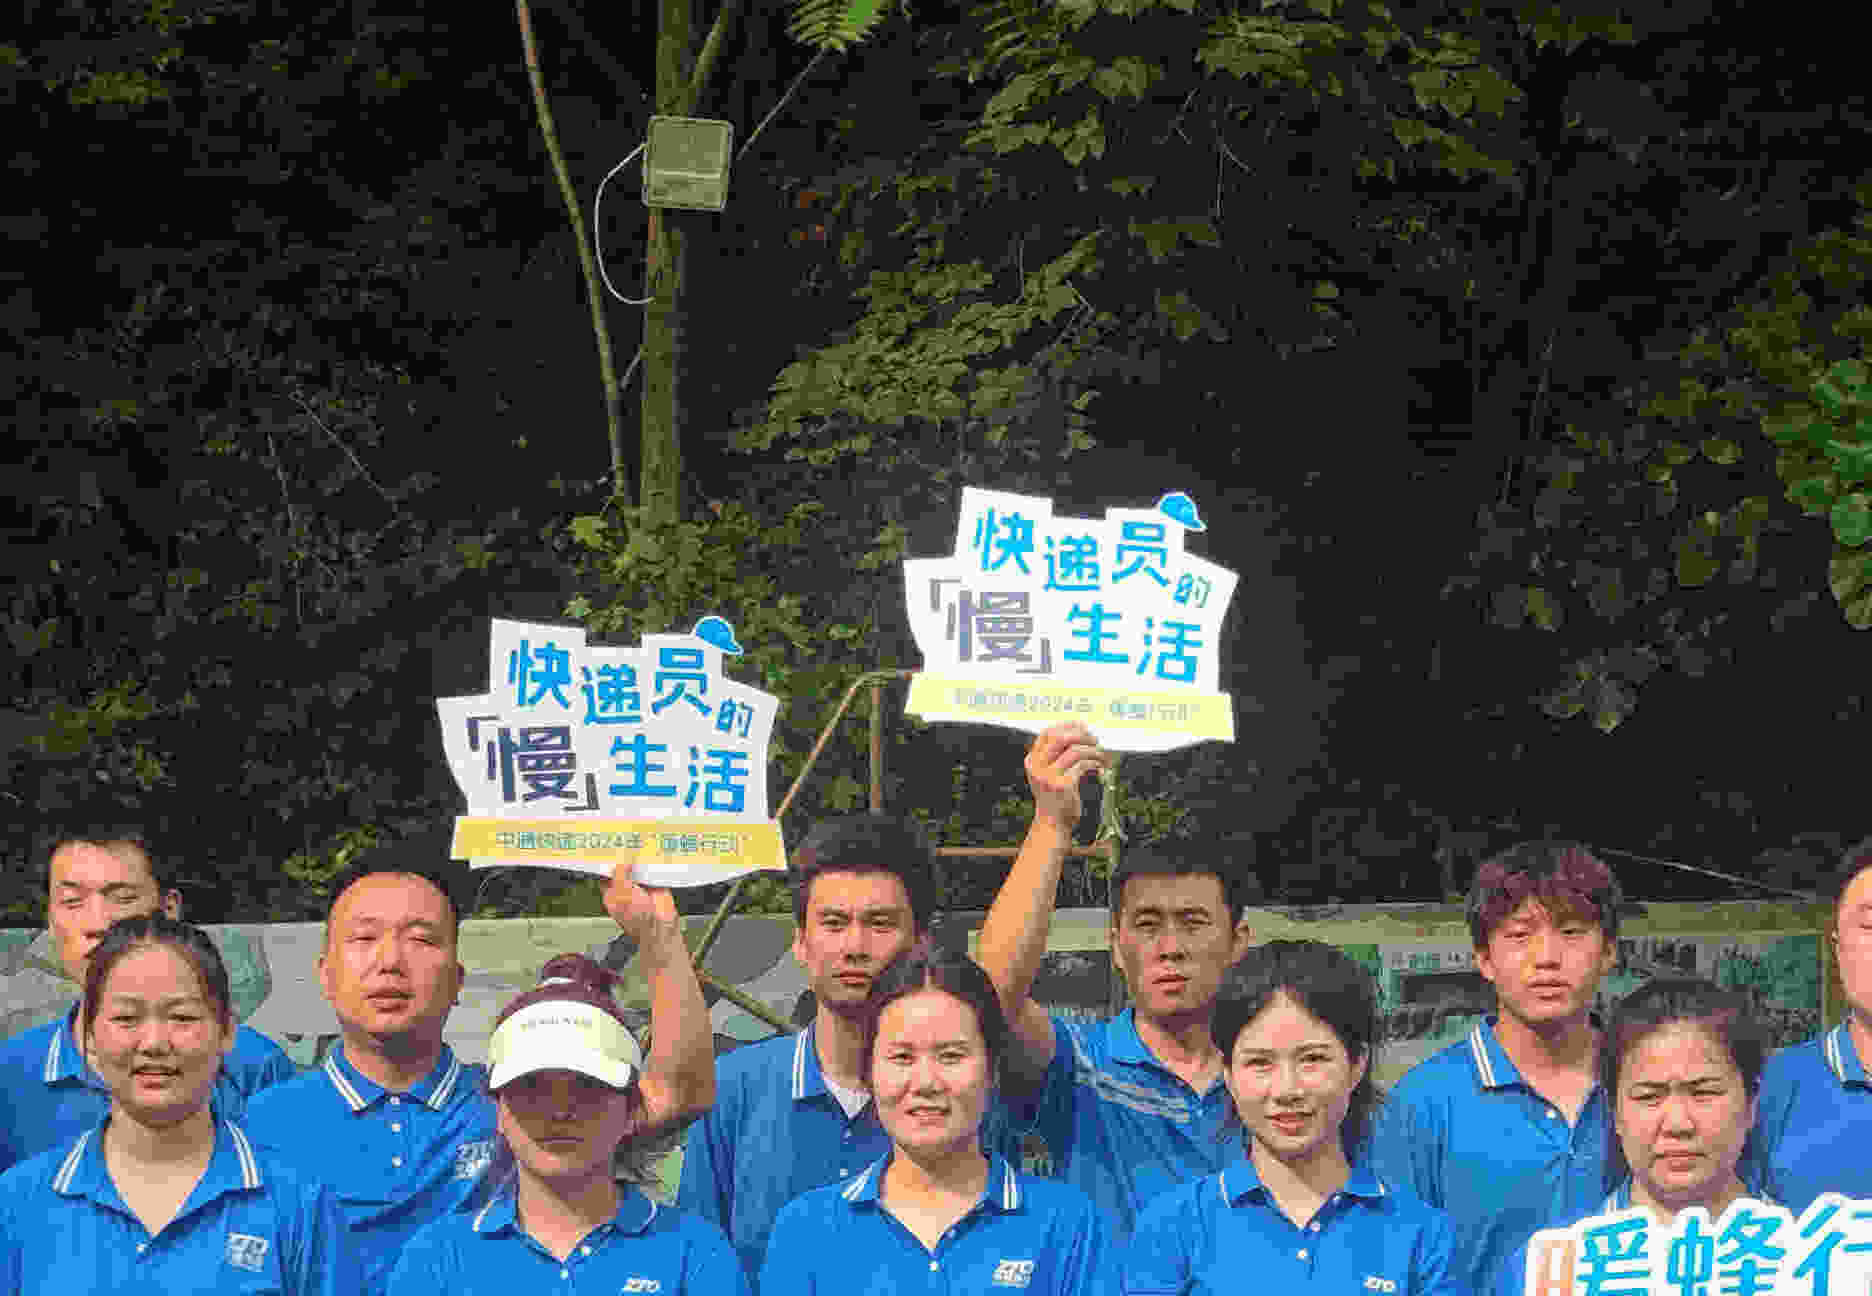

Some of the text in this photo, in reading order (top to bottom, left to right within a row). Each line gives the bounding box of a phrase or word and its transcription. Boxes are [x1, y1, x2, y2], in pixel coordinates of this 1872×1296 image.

[973, 506, 1212, 608] 快递员的
[508, 640, 753, 738] 快递员的
[621, 1279, 661, 1295] ZTO
[1363, 1276, 1397, 1291] ZTO
